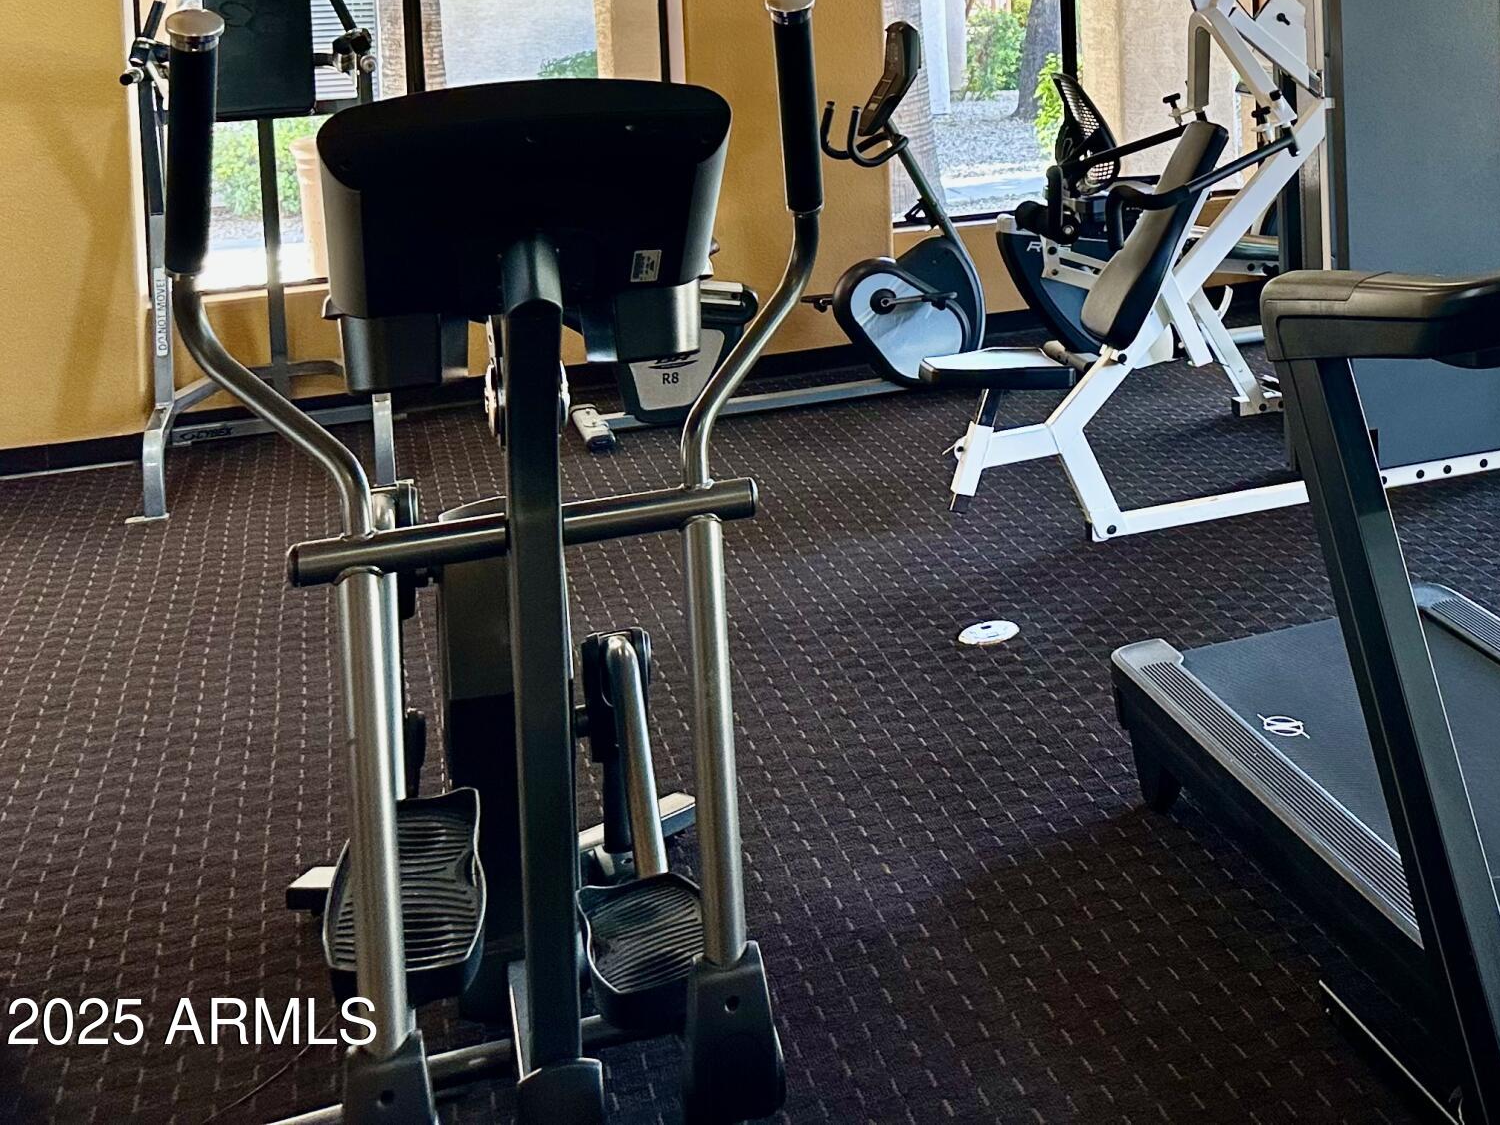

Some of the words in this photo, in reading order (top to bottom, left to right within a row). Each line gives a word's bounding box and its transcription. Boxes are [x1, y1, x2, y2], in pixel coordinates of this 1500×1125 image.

[156, 315, 167, 334] NOT
[157, 336, 168, 351] DO
[662, 372, 679, 385] R8
